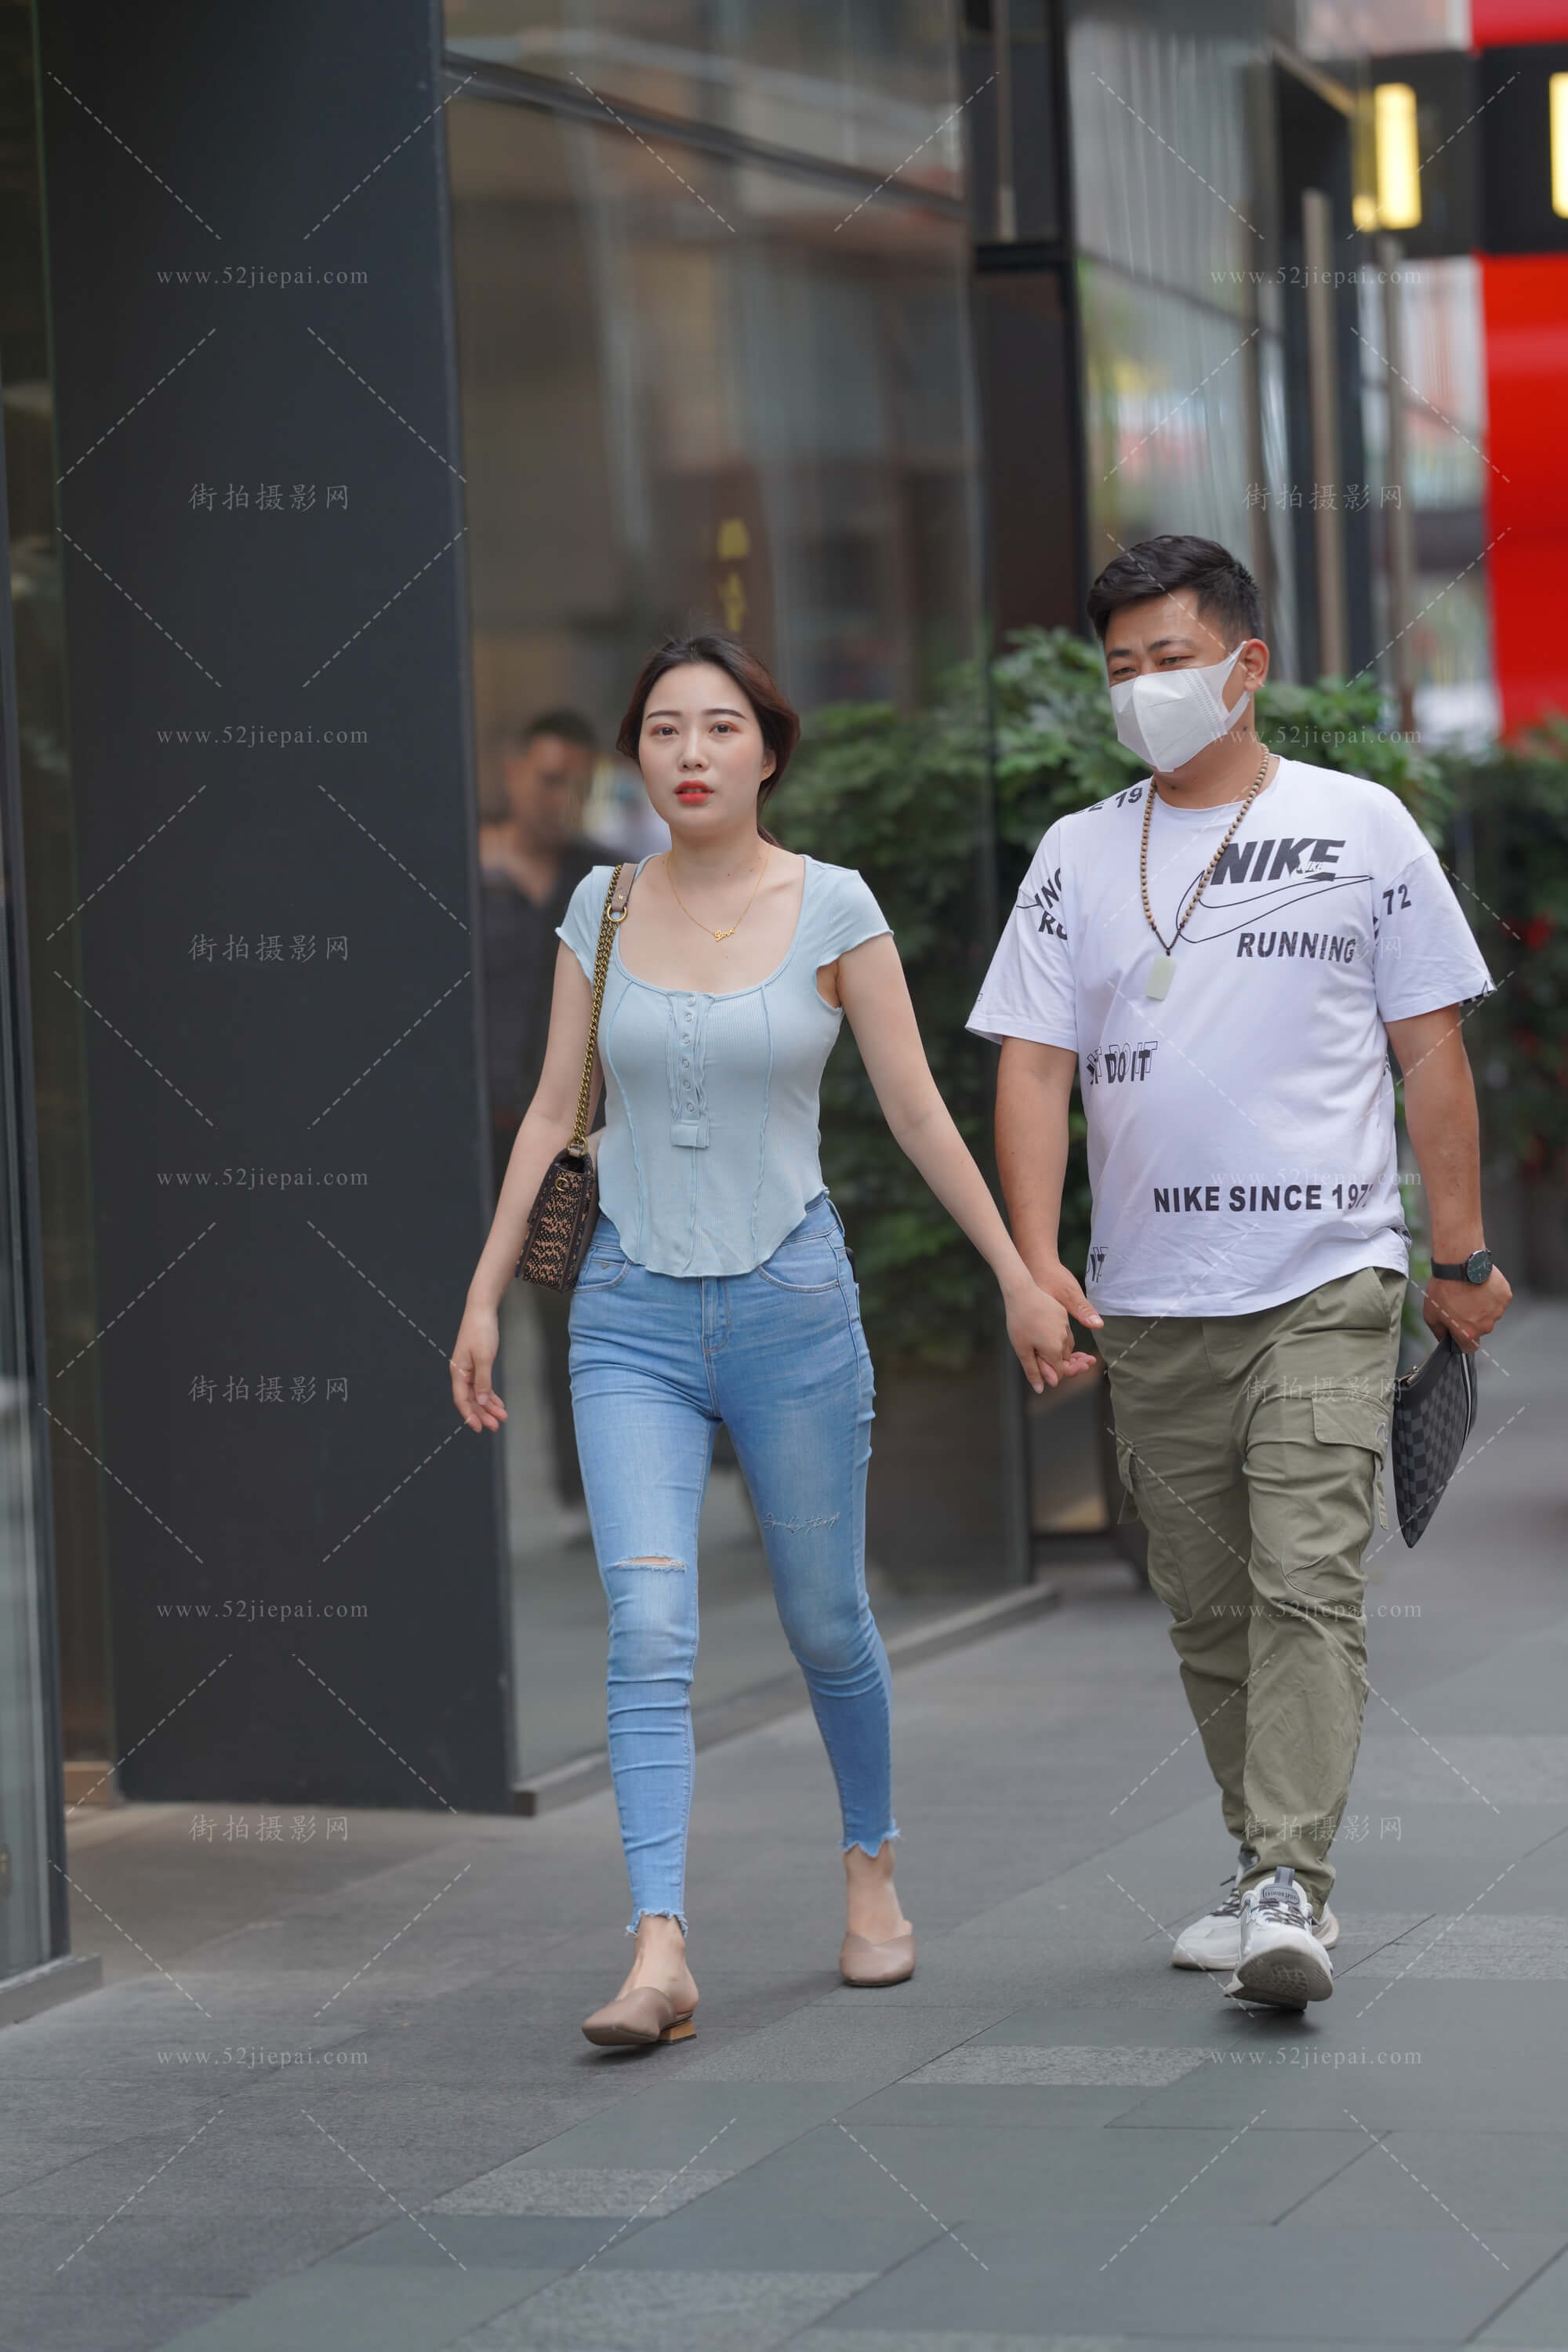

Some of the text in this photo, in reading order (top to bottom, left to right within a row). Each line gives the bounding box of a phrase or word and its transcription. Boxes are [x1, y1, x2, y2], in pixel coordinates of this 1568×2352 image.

[1210, 838, 1346, 885] NIKE
[1383, 884, 1411, 915] 72
[1236, 931, 1356, 964] RUNNING
[1153, 1184, 1374, 1212] NIKE SINCE 197
